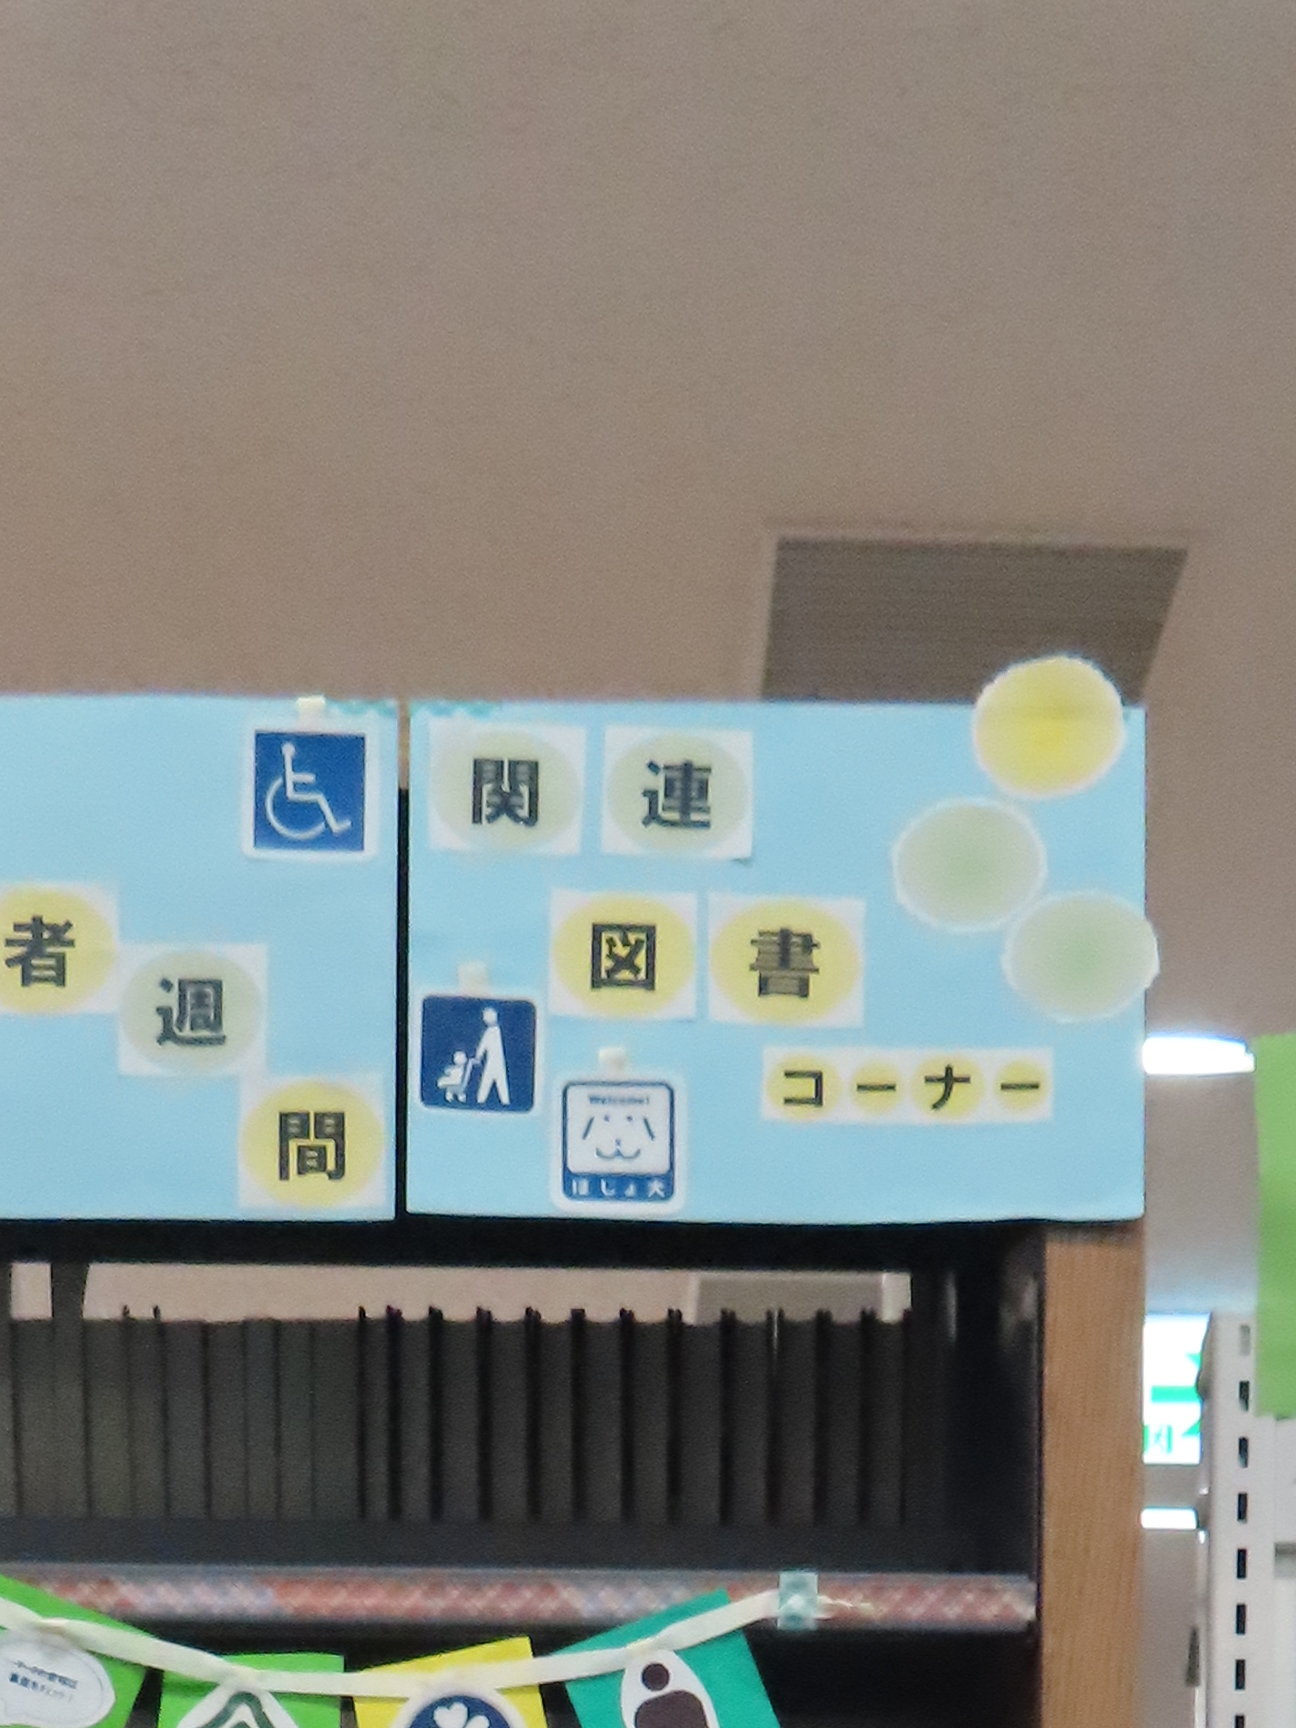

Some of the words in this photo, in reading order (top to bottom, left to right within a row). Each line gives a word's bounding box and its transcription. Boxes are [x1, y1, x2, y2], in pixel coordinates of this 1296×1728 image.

[470, 757, 713, 831] 関連
[590, 920, 818, 1000] 図書
[782, 1065, 1044, 1110] コーナー
